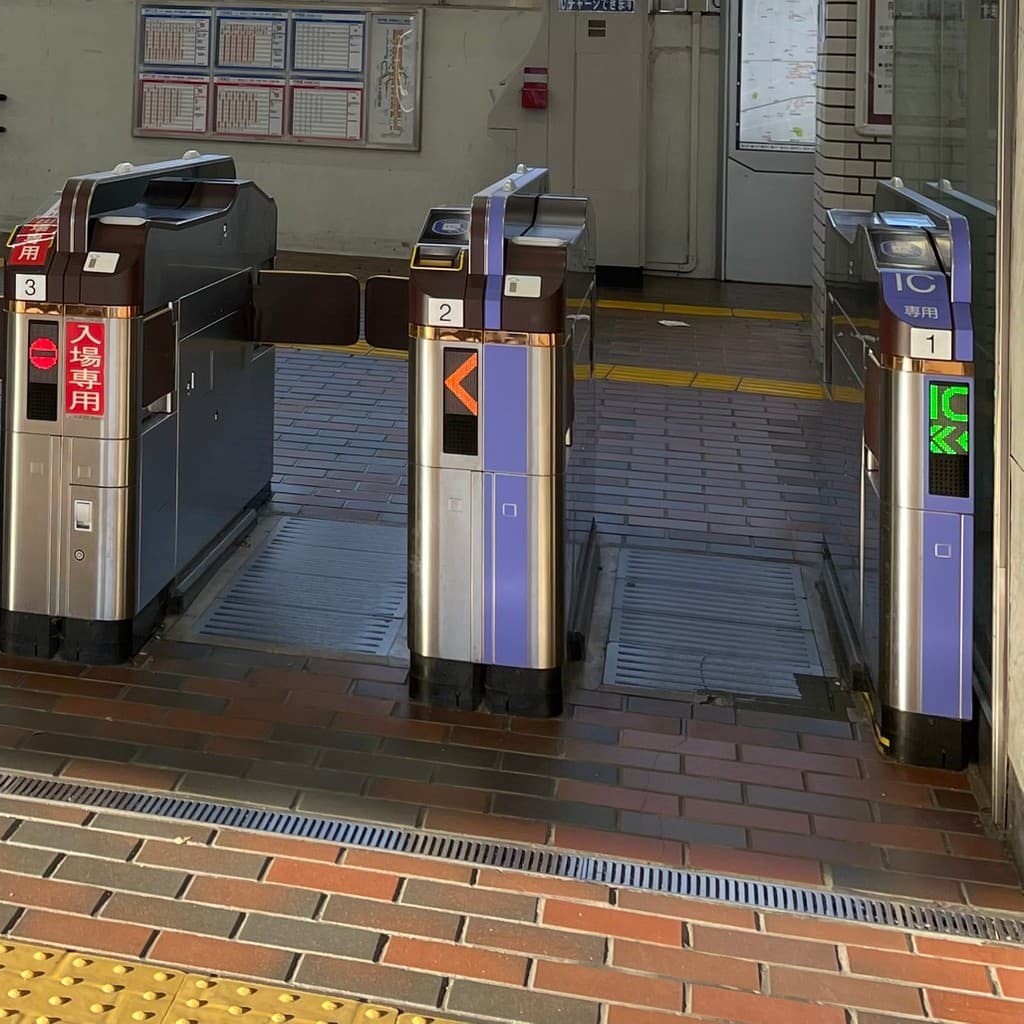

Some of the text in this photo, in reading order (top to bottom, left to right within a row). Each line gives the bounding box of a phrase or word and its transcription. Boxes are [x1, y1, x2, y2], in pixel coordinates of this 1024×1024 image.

[24, 278, 37, 296] 3
[894, 273, 936, 294] IC
[439, 303, 452, 322] 2
[903, 305, 939, 320] 専用
[925, 334, 936, 354] 1
[69, 324, 102, 413] 入場専用
[929, 384, 969, 423] IC
